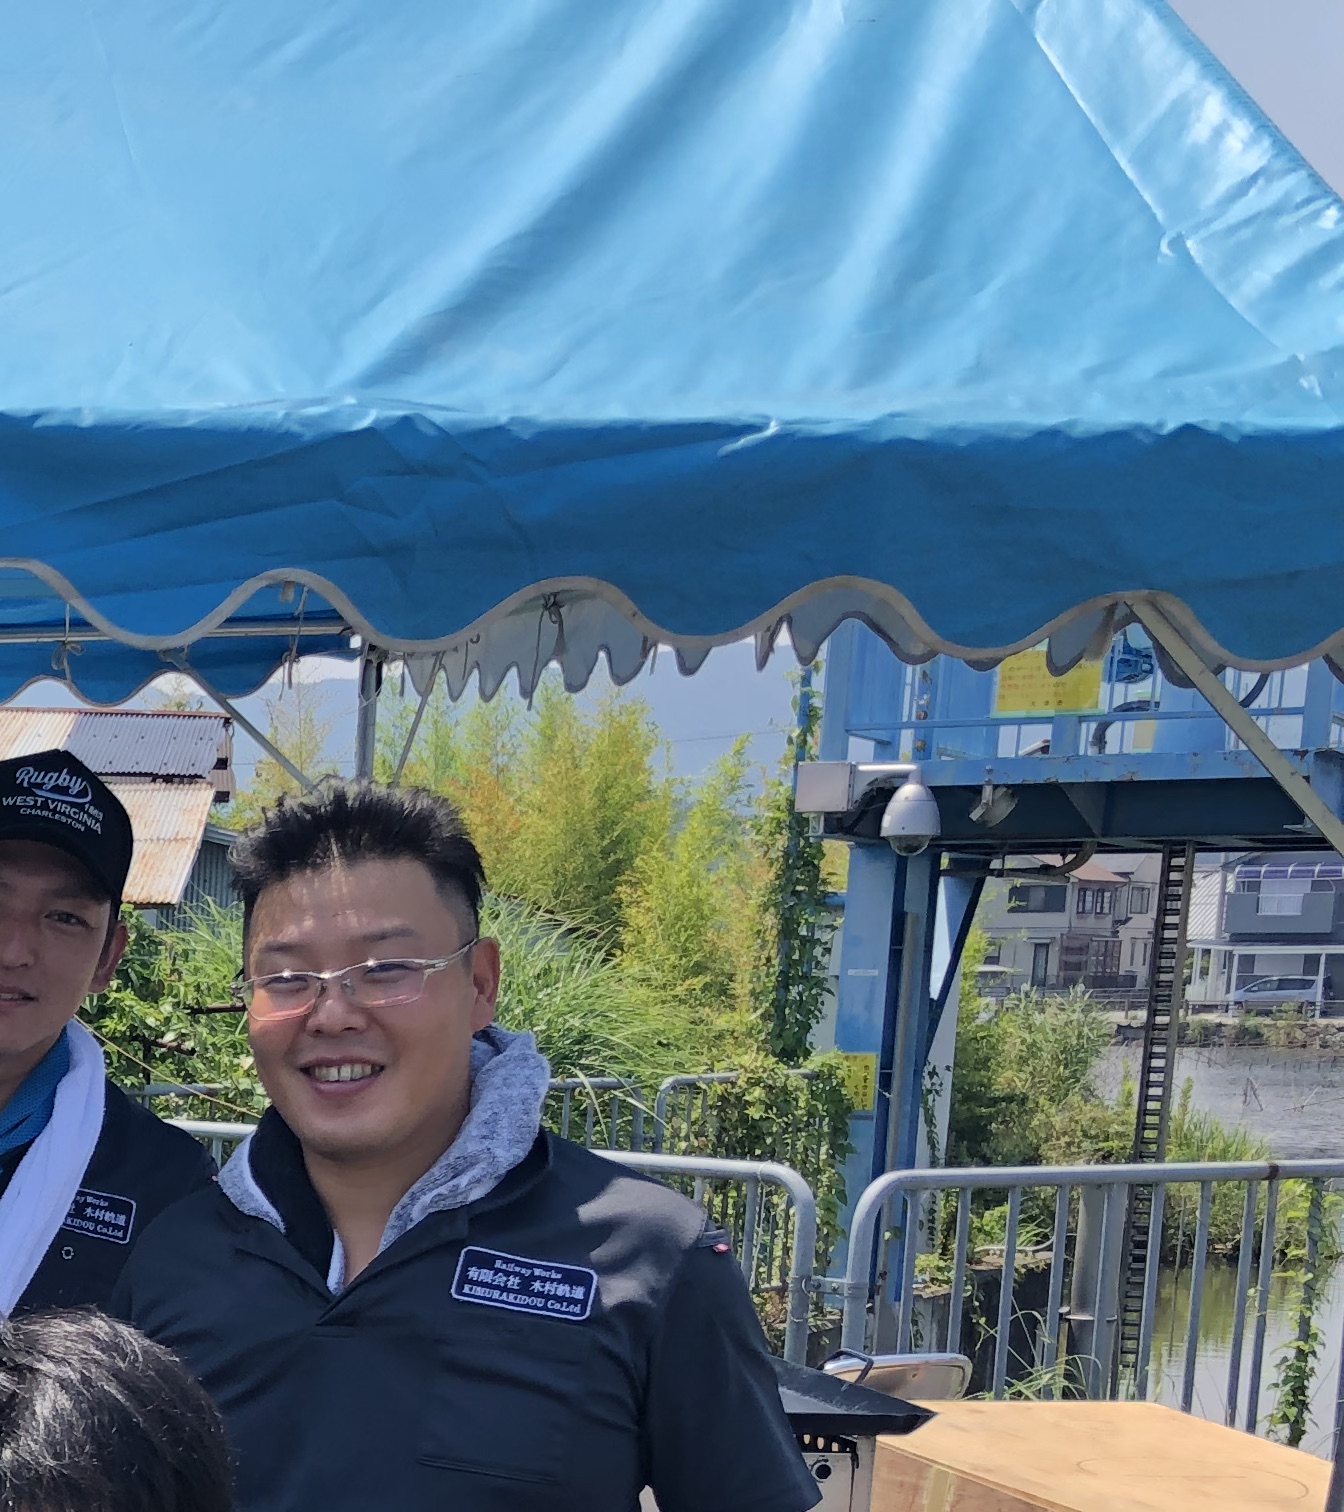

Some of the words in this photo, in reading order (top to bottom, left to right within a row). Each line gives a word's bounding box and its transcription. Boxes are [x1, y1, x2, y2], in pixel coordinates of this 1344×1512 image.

[15, 766, 88, 796] Rugby
[2, 795, 46, 807] WEST
[48, 800, 102, 835] VIRGINIA
[19, 807, 86, 832] CHARLESTON
[462, 1284, 546, 1308] KIMURAKIDOU
[466, 1266, 522, 1290] 有限会社
[529, 1279, 587, 1300] 木村軌道
